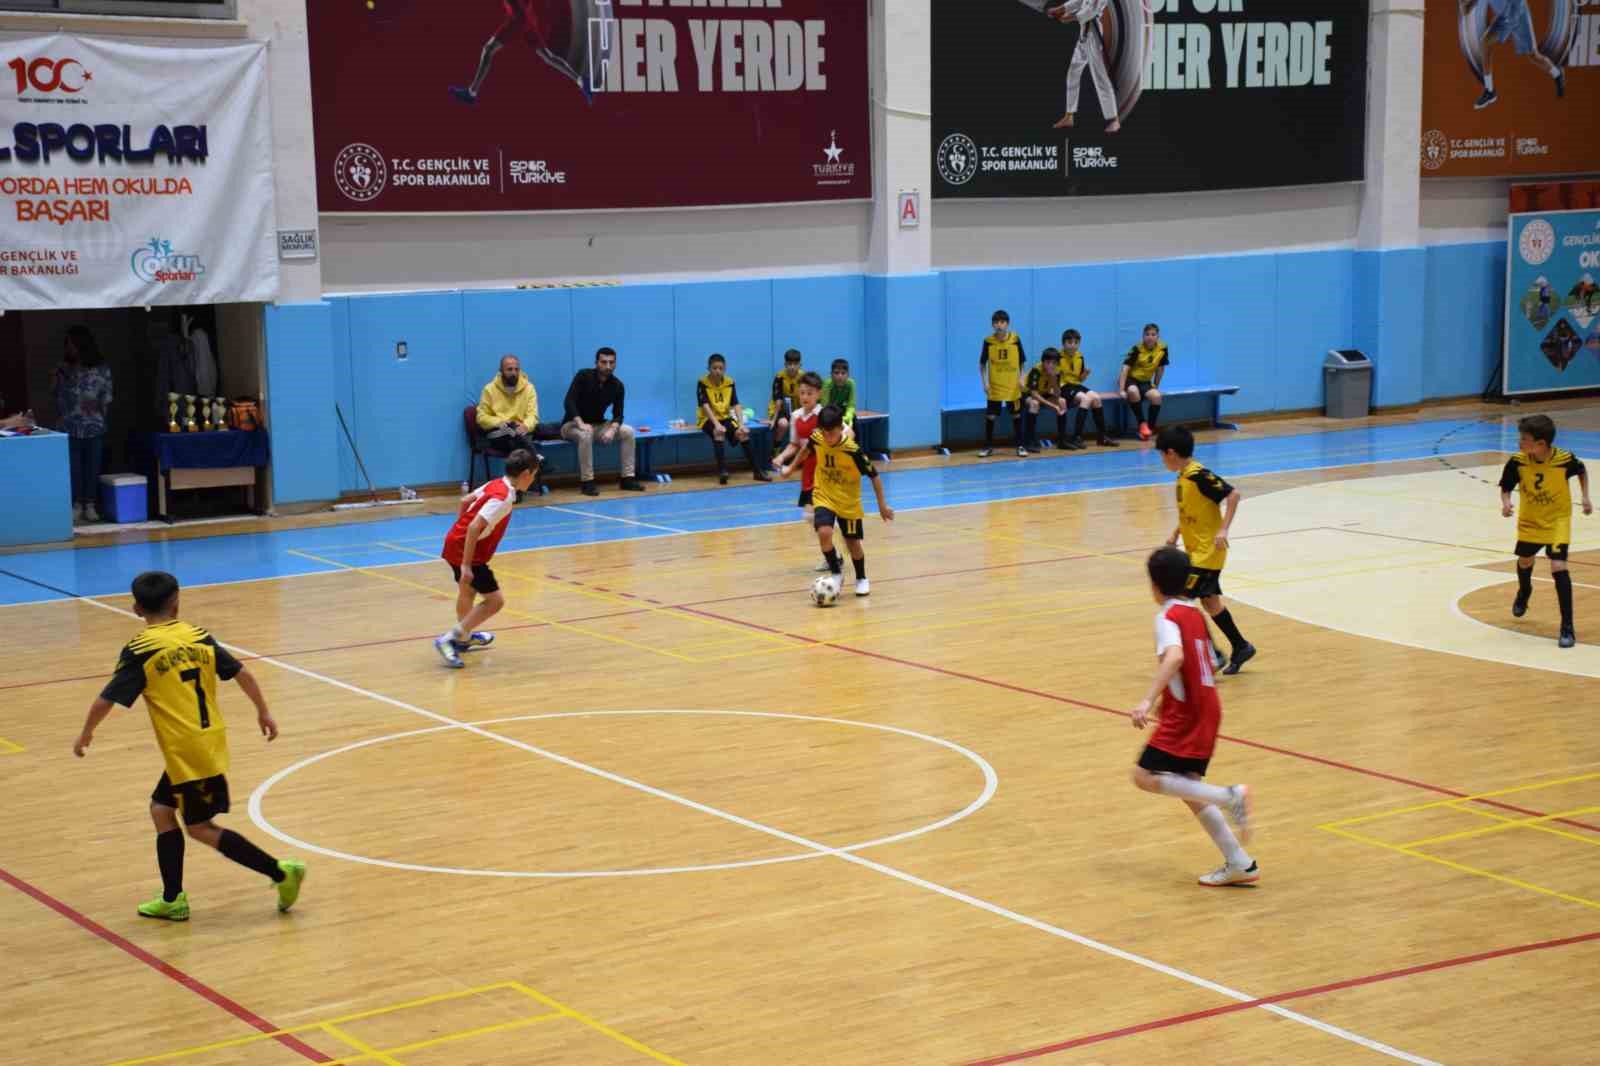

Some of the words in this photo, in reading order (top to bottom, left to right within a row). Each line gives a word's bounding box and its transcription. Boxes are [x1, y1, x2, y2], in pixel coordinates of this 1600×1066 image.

[588, 18, 680, 92] HER
[687, 19, 827, 91] YERDE
[1142, 23, 1212, 90] HER
[1220, 20, 1333, 88] YERDE
[1001, 144, 1043, 159] GENÇLİK
[1045, 145, 1057, 156] VE
[391, 158, 414, 171] T.C.
[417, 156, 471, 173] GENÇLİK
[473, 158, 489, 170] VE
[981, 160, 1006, 171] SPOR
[1008, 157, 1058, 170] BAKANLIĞI
[63, 177, 109, 195] HEM
[112, 177, 193, 195] OKULDA
[392, 174, 424, 186] SPOR
[427, 171, 490, 186] BAKANLIĞI
[15, 199, 110, 225] BAŞARI
[903, 198, 917, 219] A
[0, 248, 57, 263] GENÇLİK
[60, 250, 77, 261] VE
[10, 262, 79, 276] BAKANLIĞI
[825, 454, 835, 468] 11
[1534, 472, 1545, 490] 2
[180, 667, 211, 729] 7
